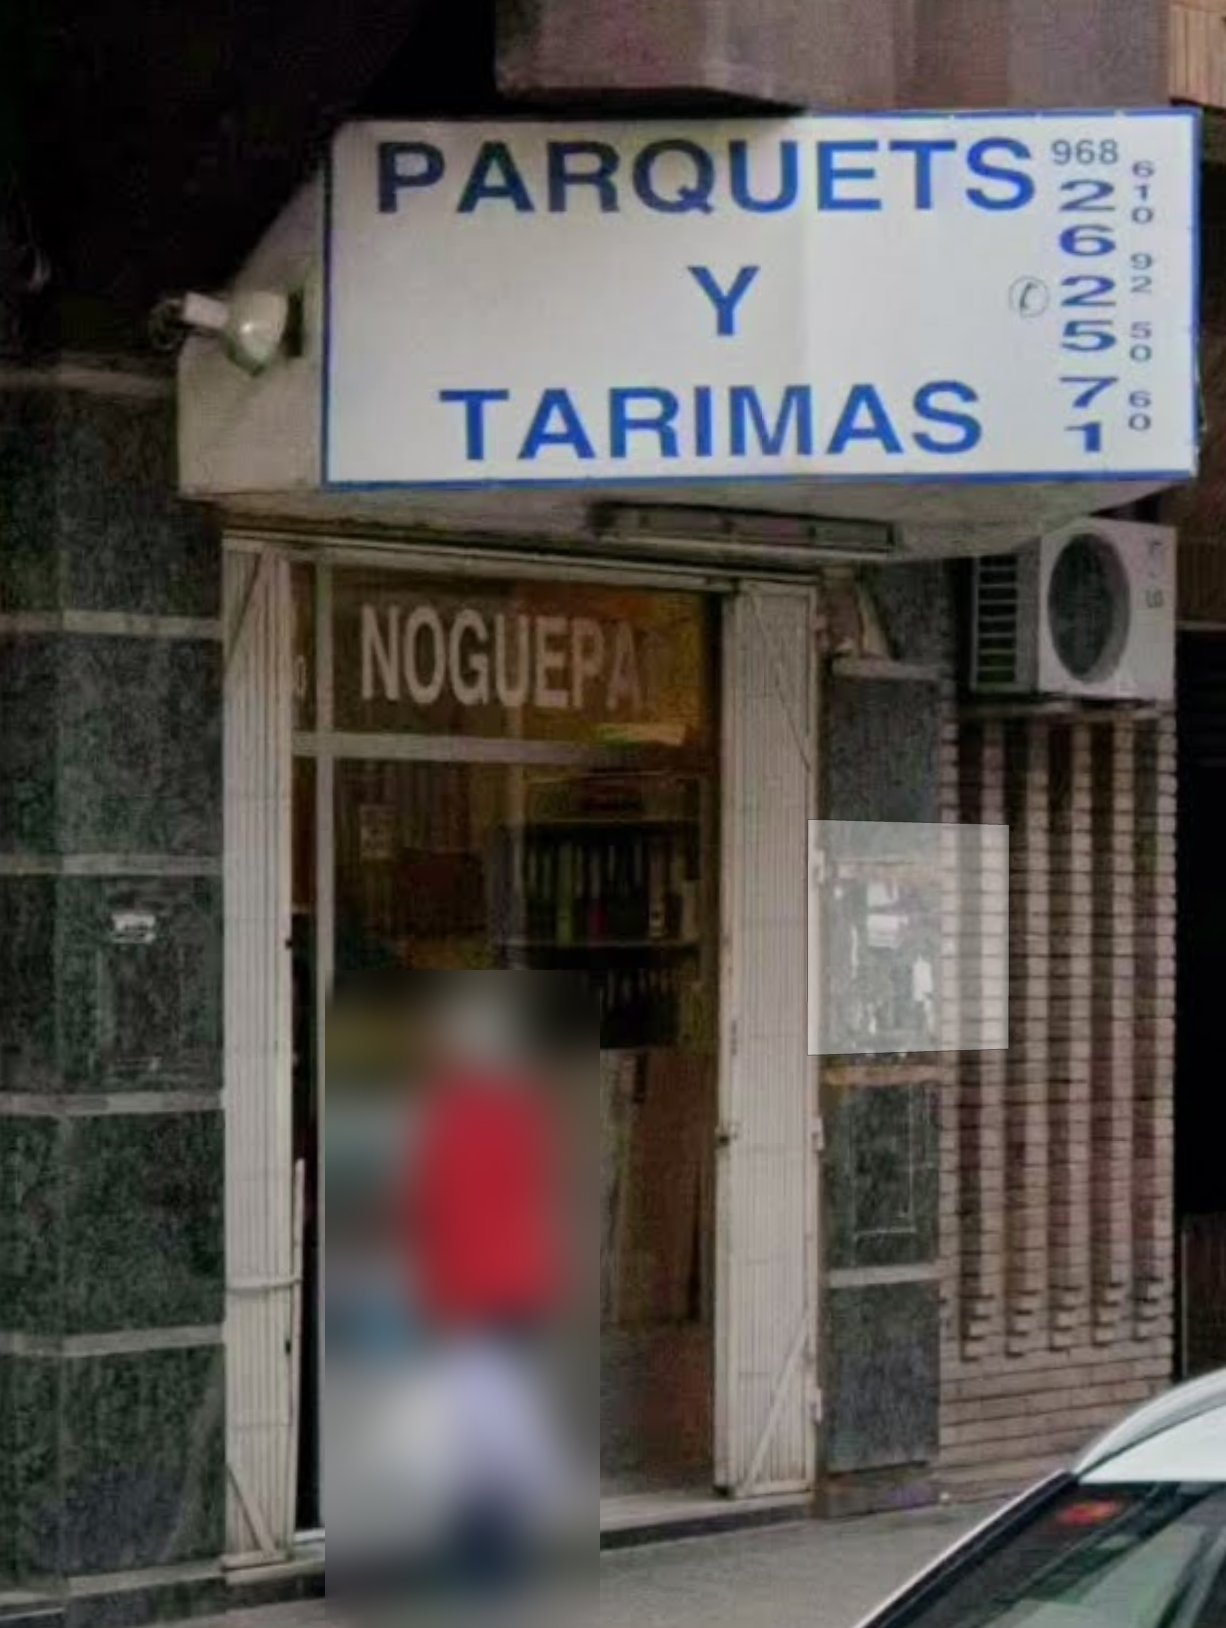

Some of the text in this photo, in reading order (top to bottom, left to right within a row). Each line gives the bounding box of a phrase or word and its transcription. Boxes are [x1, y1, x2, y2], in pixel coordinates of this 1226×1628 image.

[376, 137, 1036, 214] PARQUETS
[1051, 139, 1119, 165] 968
[687, 265, 760, 337] Y
[438, 379, 983, 460] TARIMAS
